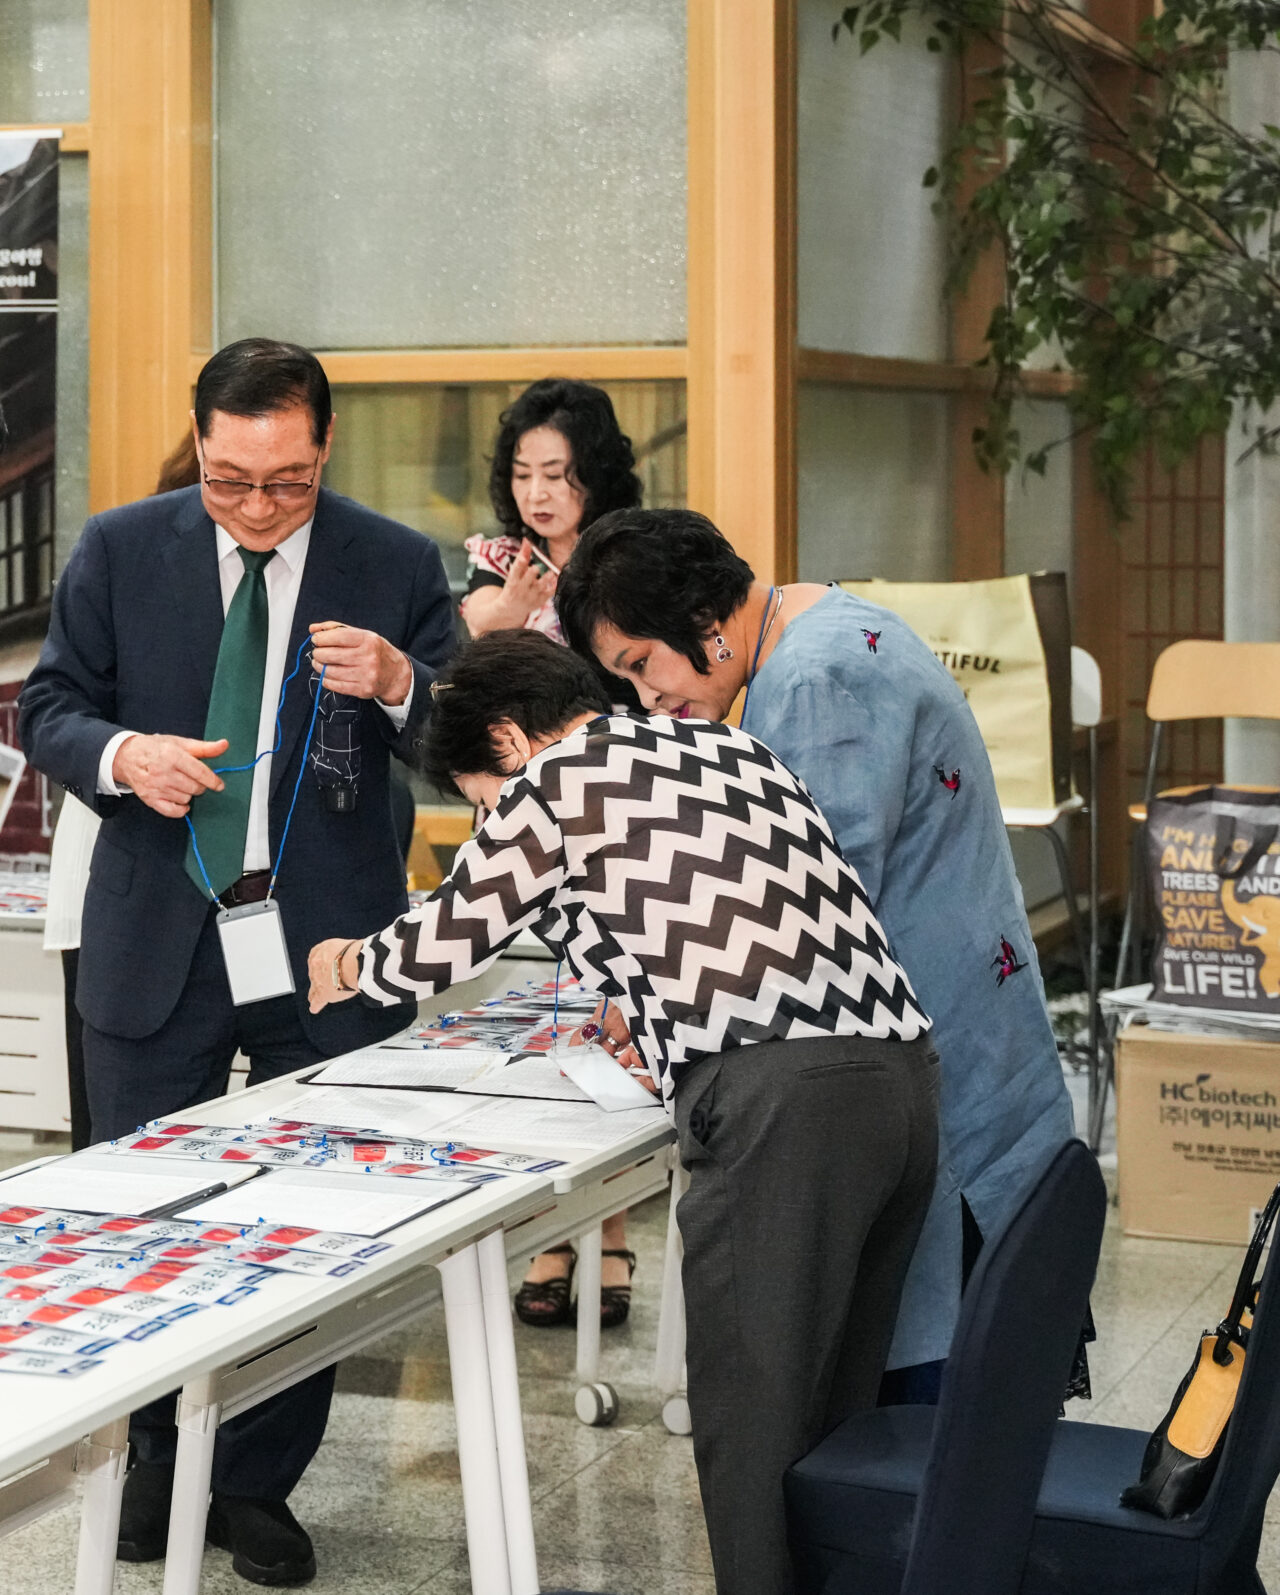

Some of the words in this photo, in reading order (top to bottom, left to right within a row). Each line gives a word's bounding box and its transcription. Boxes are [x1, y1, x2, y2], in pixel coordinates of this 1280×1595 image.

[934, 651, 1001, 673] TIFUL
[1161, 870, 1219, 892] TREES
[1161, 905, 1225, 933] SAVE
[1221, 952, 1256, 966] WILD
[1163, 961, 1257, 999] LIFE!
[1160, 1082, 1195, 1102] HC
[1198, 1086, 1277, 1107] biotech
